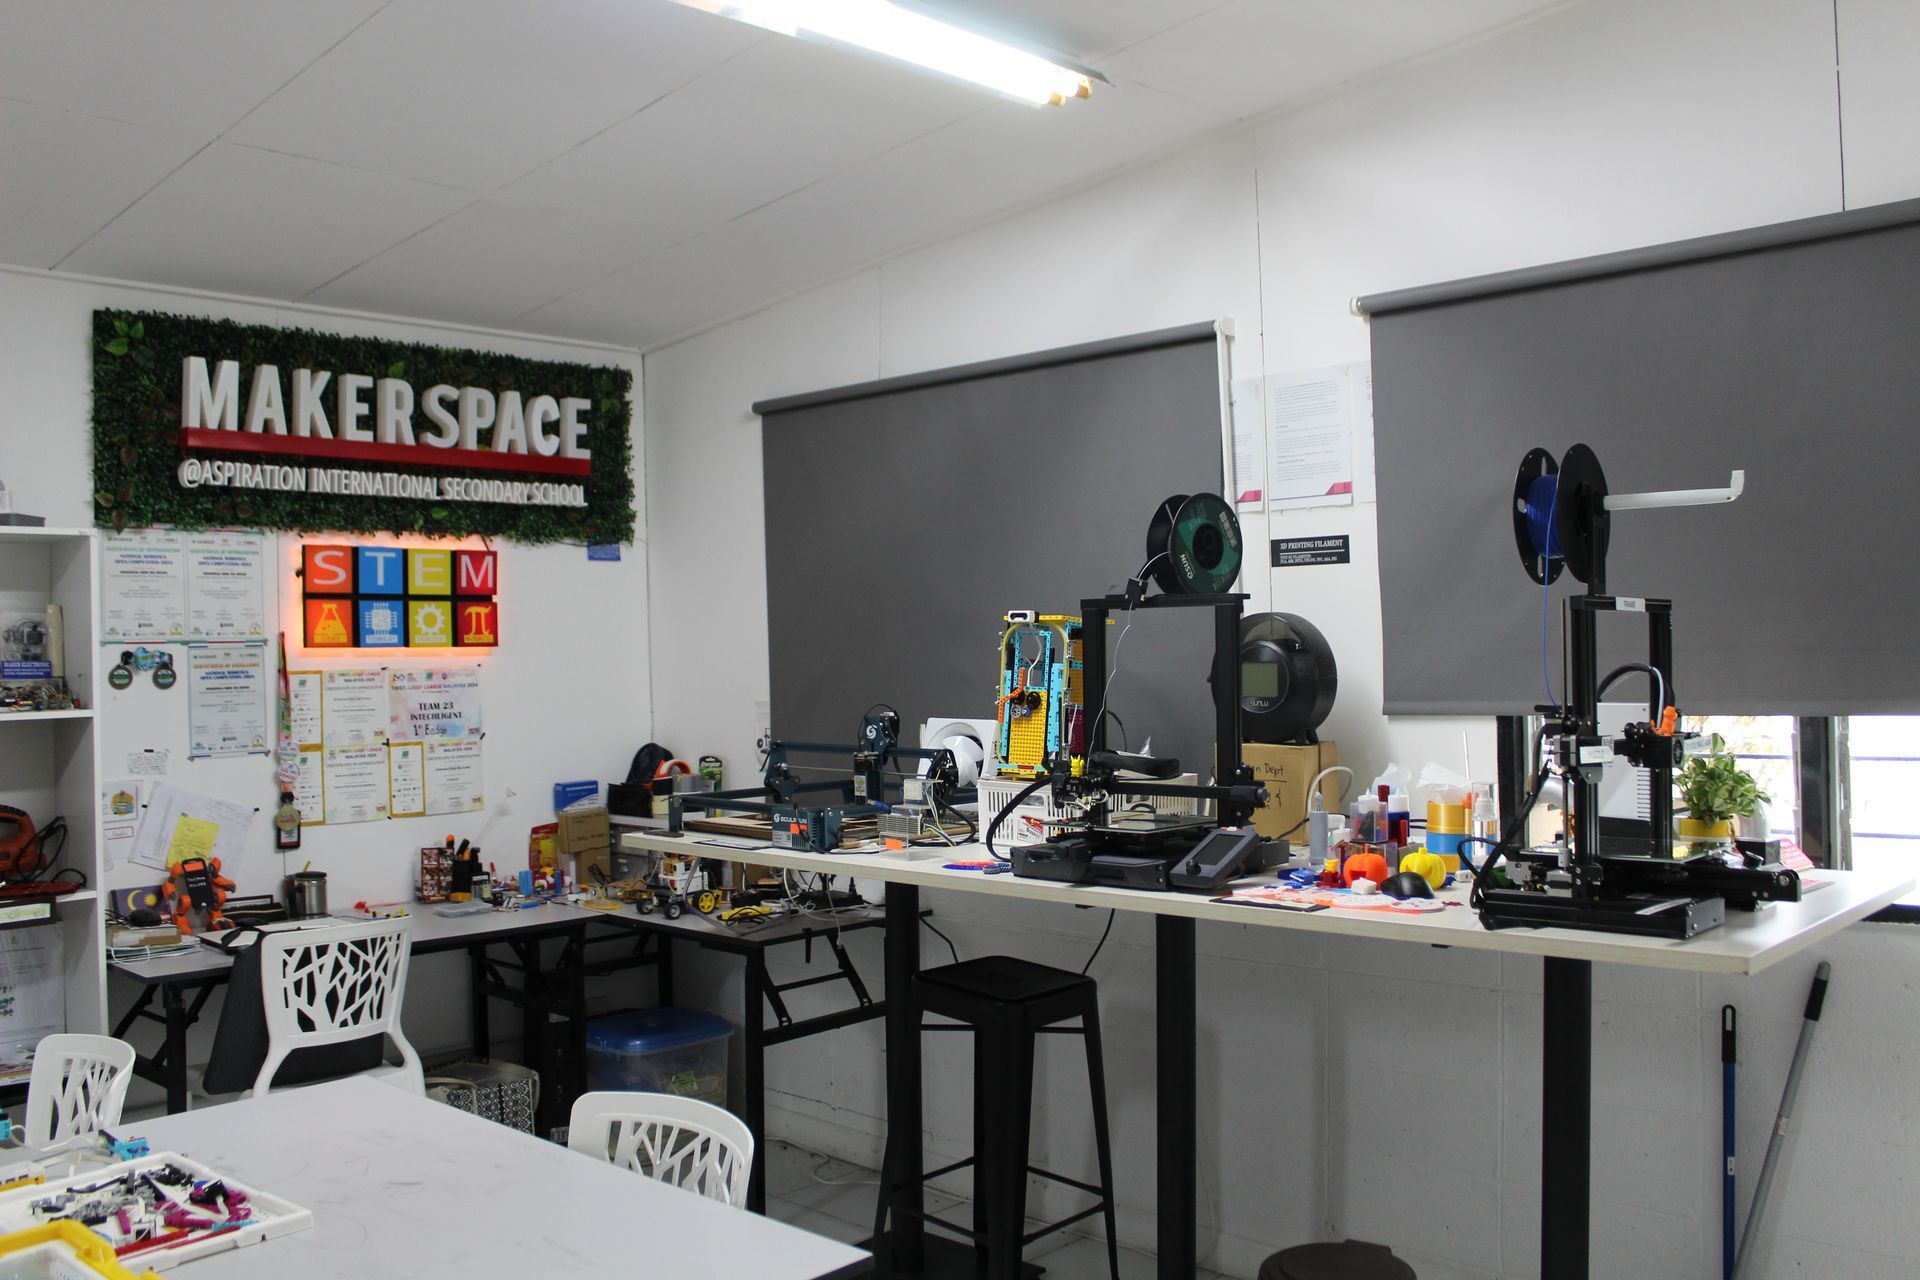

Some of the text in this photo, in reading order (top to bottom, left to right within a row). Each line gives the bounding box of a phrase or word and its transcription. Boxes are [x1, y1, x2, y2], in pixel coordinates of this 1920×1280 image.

[181, 356, 591, 459] MAKERSPACE
[178, 458, 588, 507] @ASPIRATION INTERNATIONAL SECONDARY SCHOOL
[1288, 541, 1314, 549] PRINTING
[1314, 539, 1344, 548] FILAMENT
[313, 550, 493, 588] STEM
[418, 702, 454, 710] TEAM 23
[1264, 762, 1284, 778] Dept
